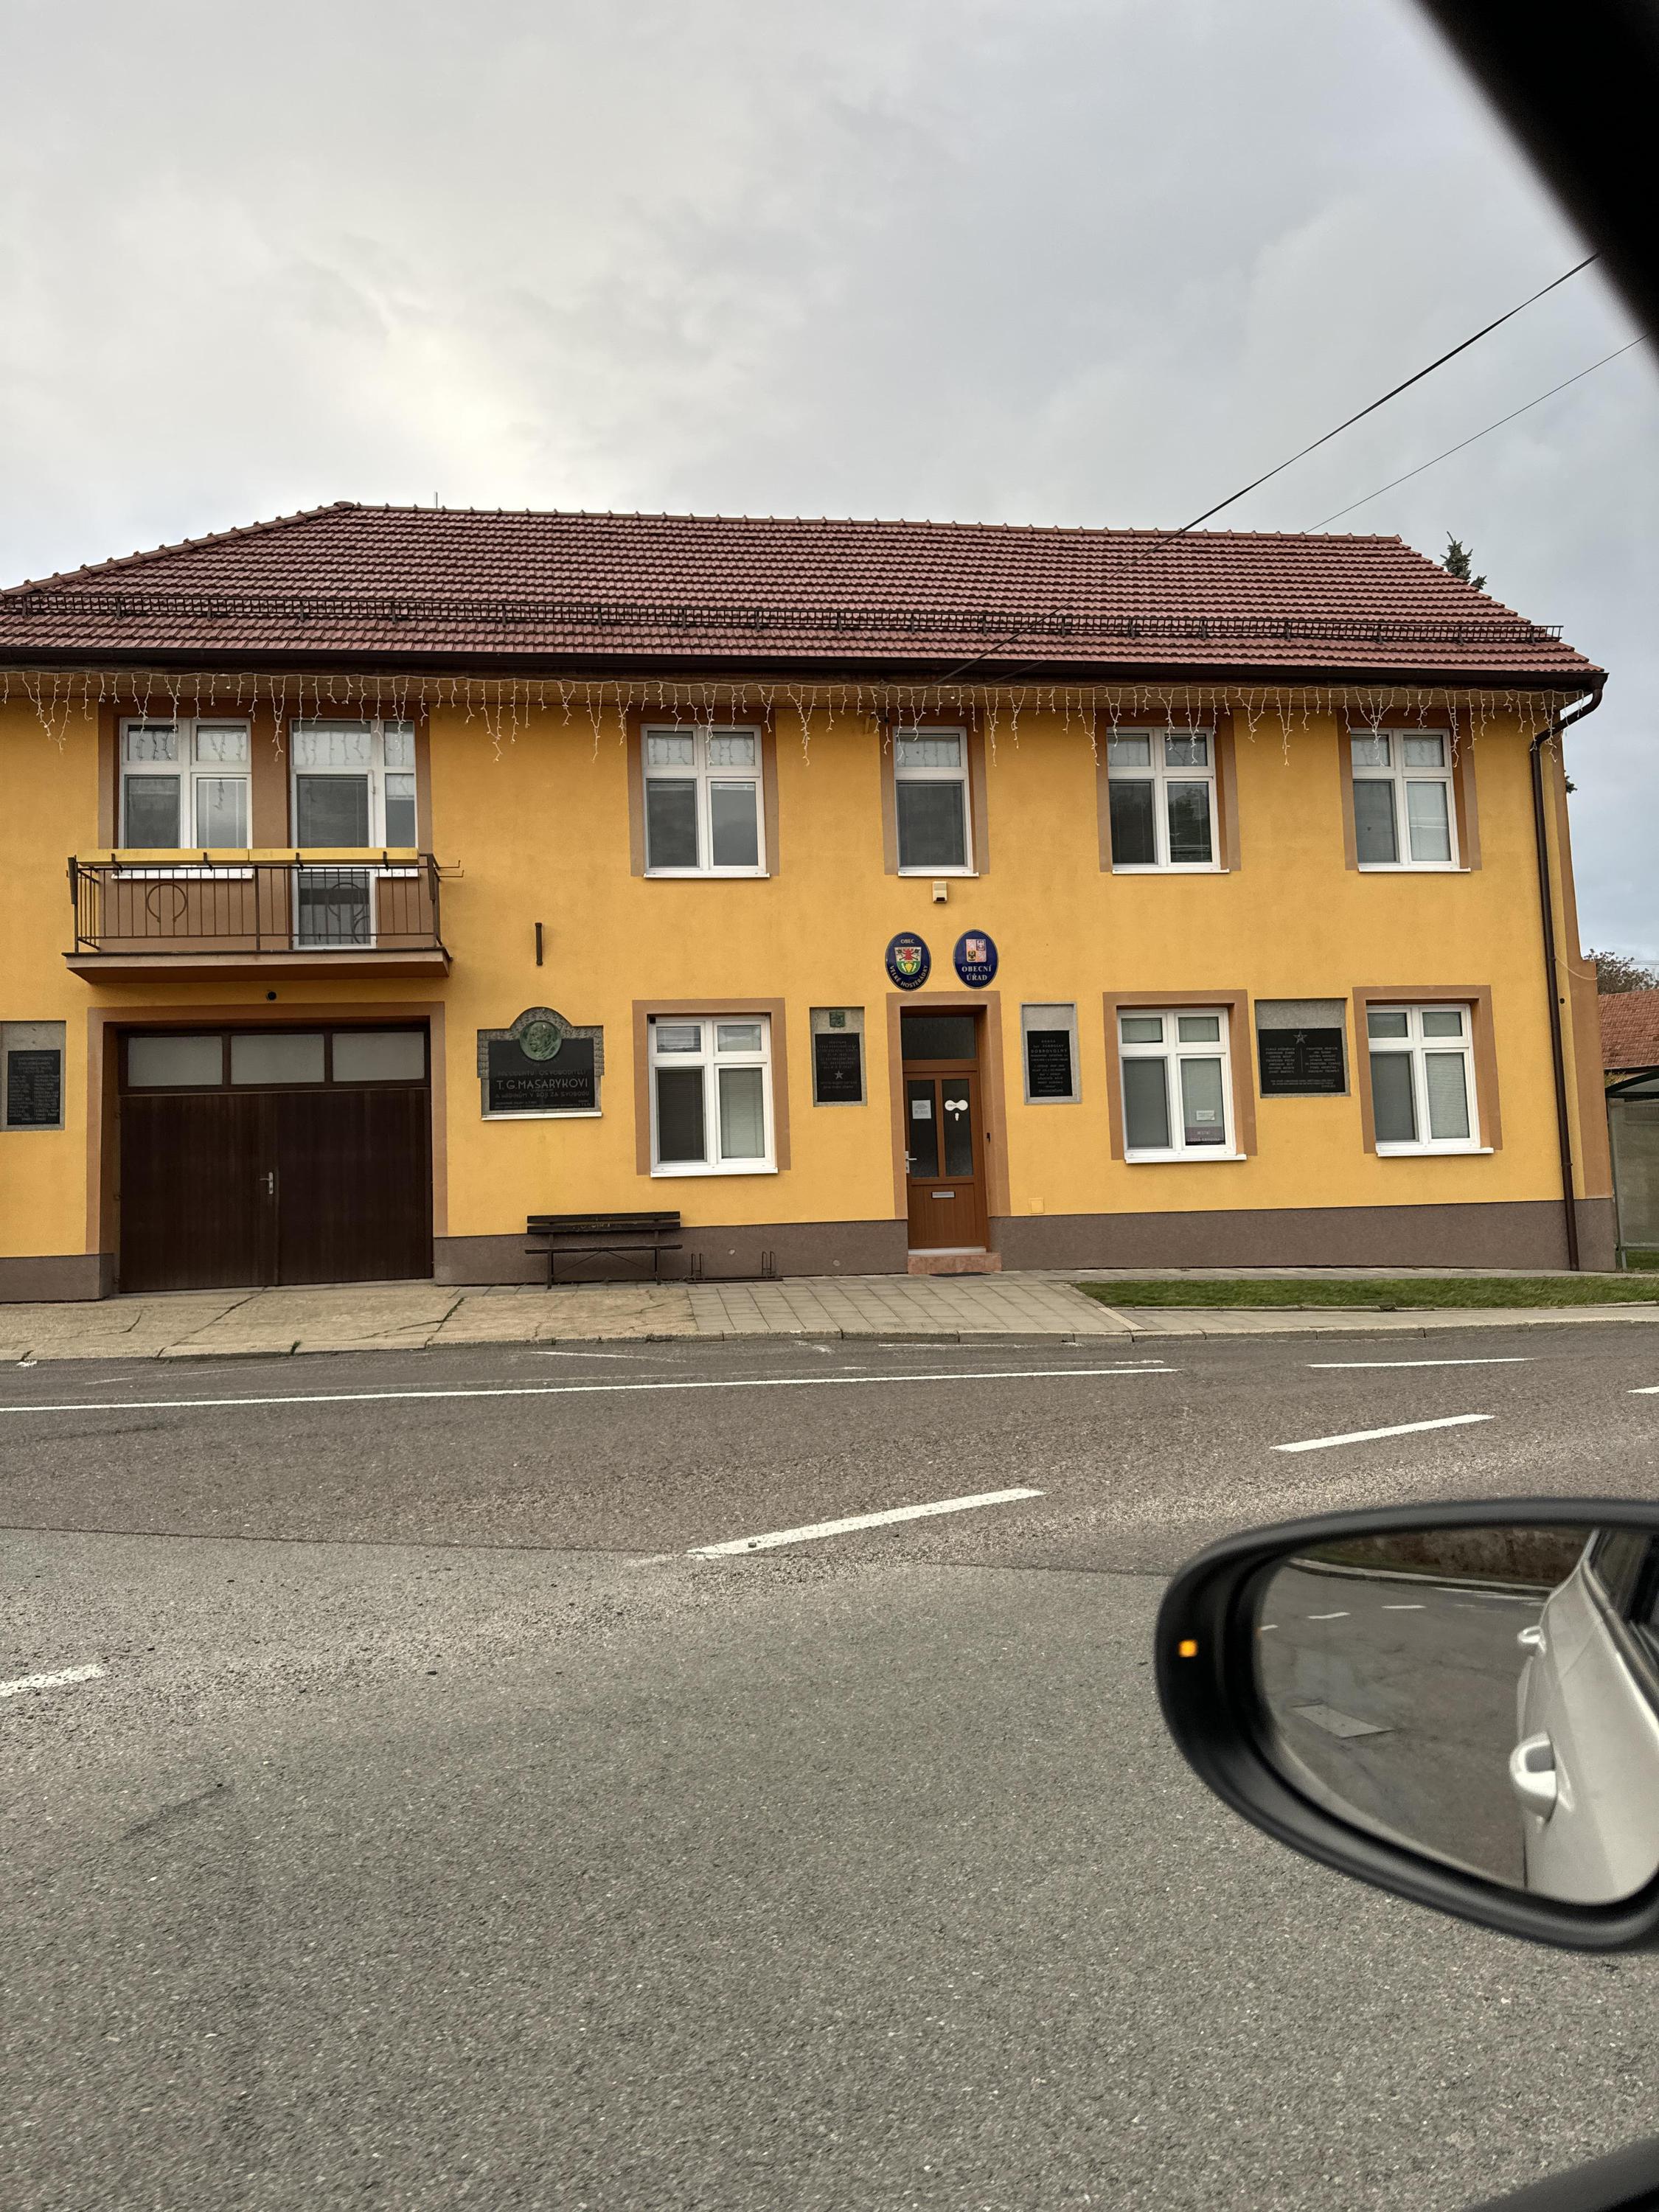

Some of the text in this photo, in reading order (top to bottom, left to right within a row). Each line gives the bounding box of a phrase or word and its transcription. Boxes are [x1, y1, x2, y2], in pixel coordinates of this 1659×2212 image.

[961, 964, 992, 973] OBECNÍ
[889, 965, 929, 988] VELKÉ HOSTĚRÁDKY
[518, 1078, 588, 1089] MASARYKOVI
